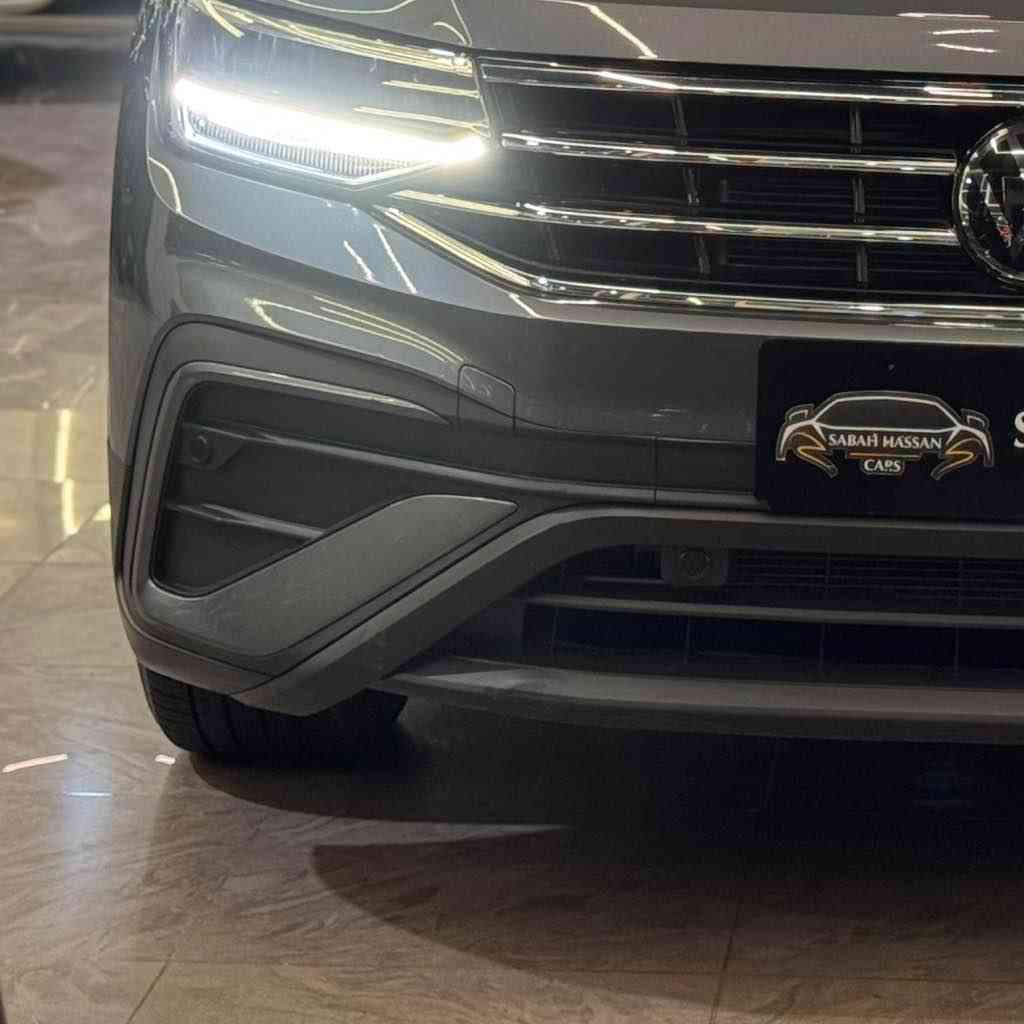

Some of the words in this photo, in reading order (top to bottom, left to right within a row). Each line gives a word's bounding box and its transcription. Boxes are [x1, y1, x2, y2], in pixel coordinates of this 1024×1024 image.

[828, 432, 878, 448] SABAH
[882, 435, 943, 450] HASSAN
[863, 459, 902, 473] CARS
